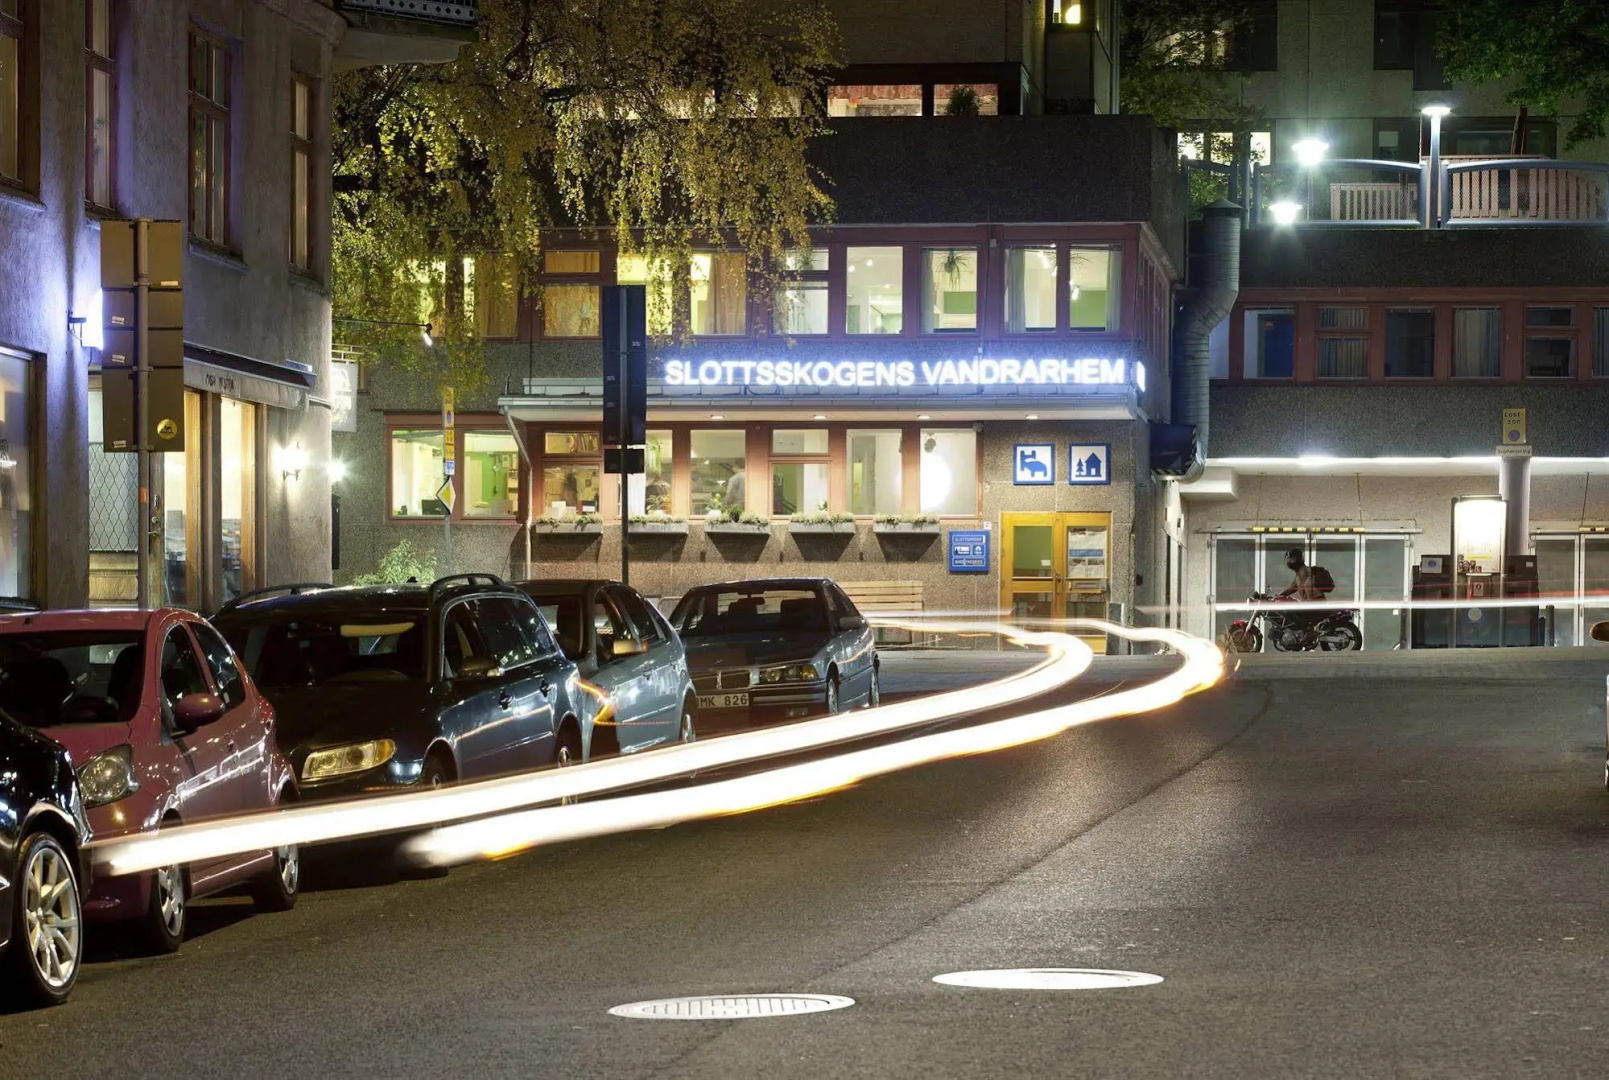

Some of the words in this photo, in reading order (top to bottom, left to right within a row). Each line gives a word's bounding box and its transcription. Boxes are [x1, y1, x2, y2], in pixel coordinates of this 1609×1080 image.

[664, 359, 915, 387] SLOTTSSKOGENS
[921, 358, 1125, 386] VANDRARHEM
[696, 696, 716, 707] MK
[724, 694, 747, 706] 826
